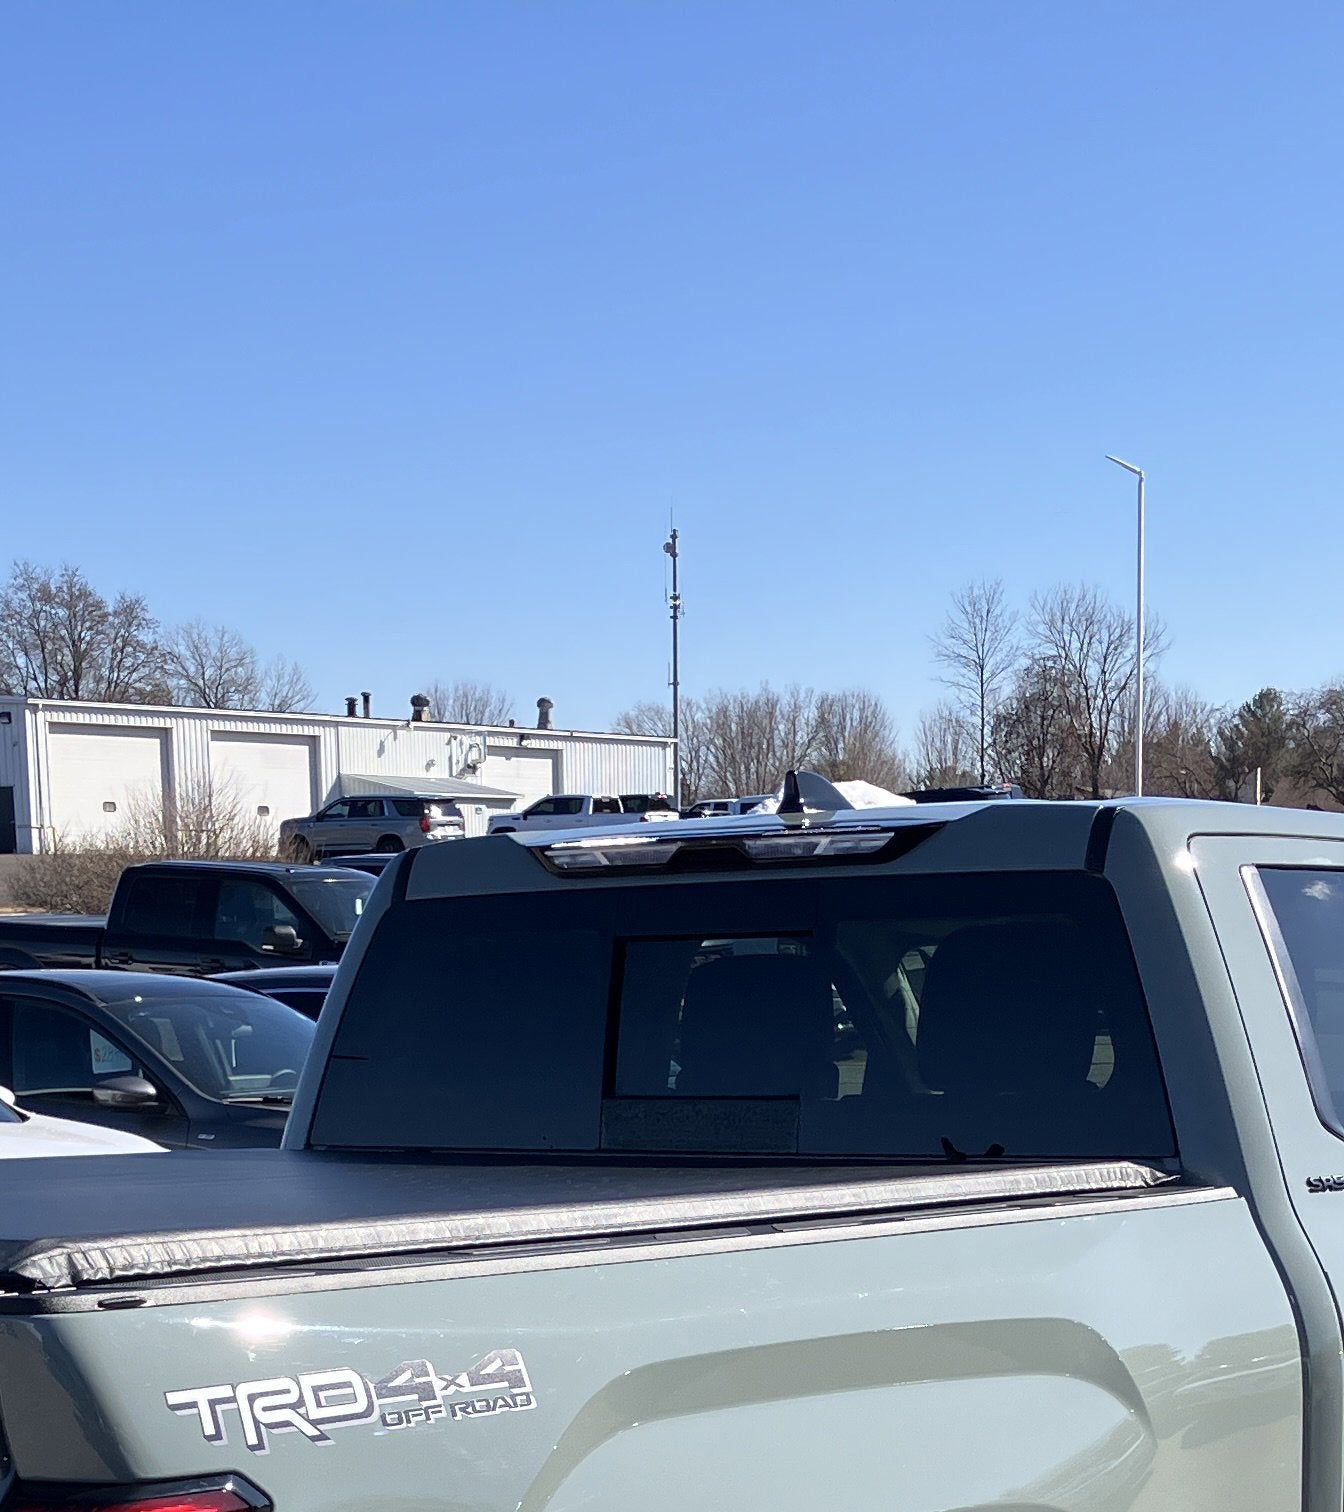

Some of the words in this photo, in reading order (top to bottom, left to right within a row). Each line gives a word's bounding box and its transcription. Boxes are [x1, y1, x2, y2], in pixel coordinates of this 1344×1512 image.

[163, 1368, 381, 1456] TRD
[373, 1349, 535, 1407] 4x4
[380, 1403, 445, 1431] OFF
[450, 1391, 538, 1421] ROAD
